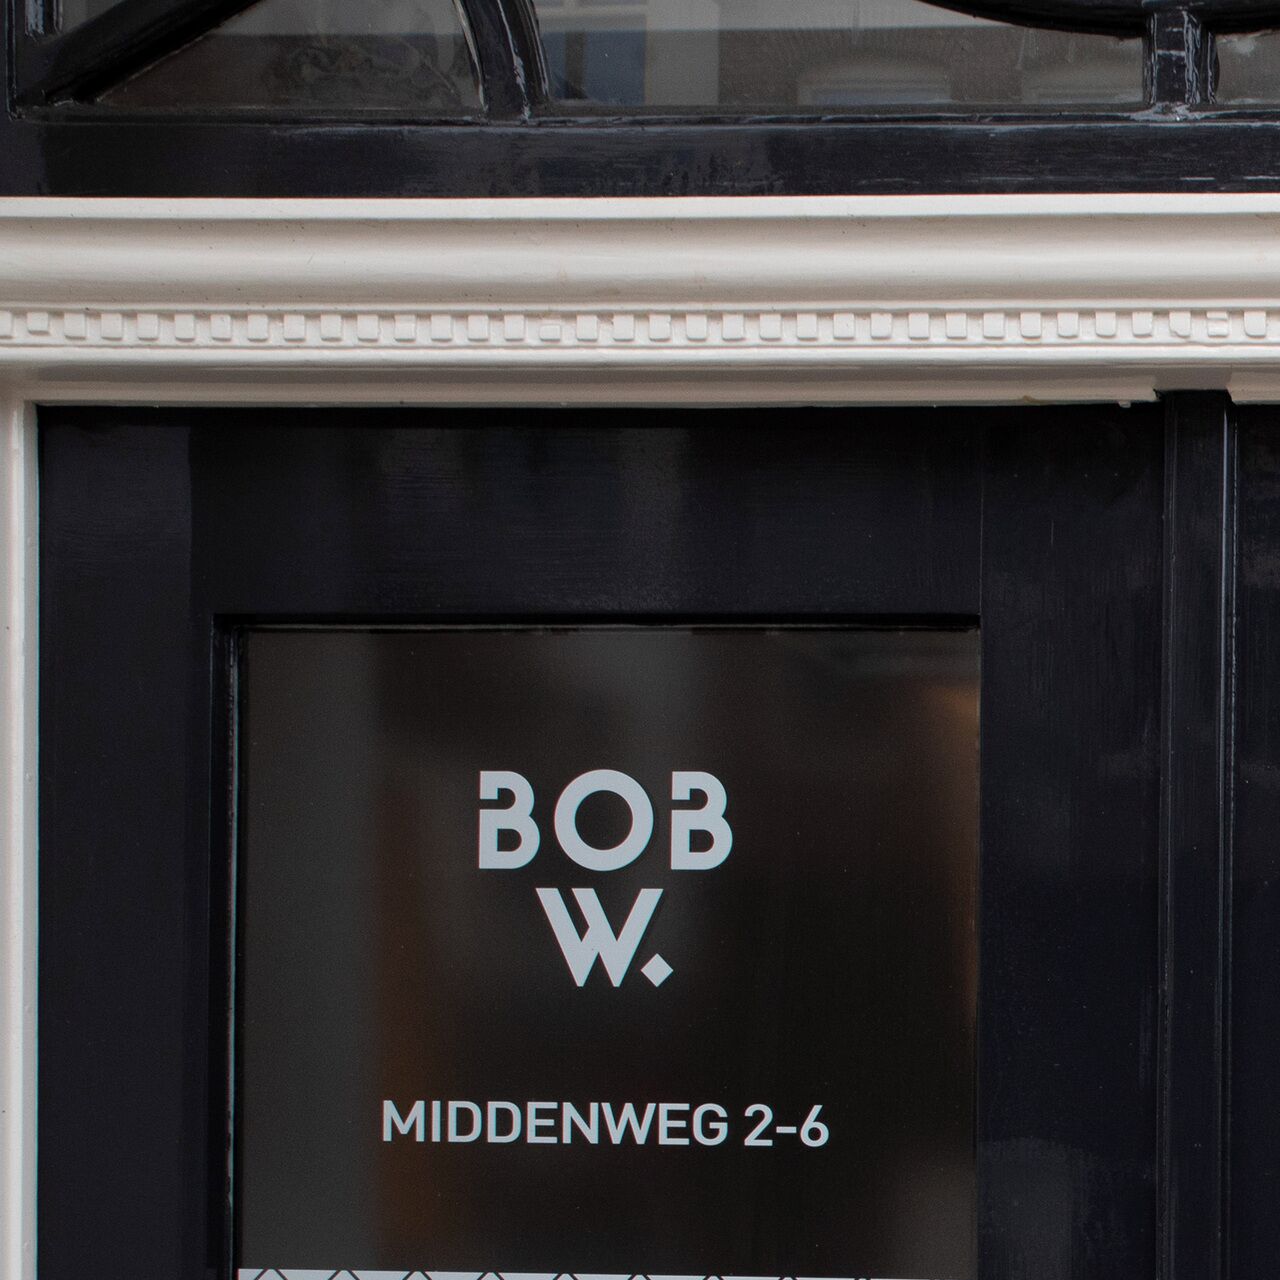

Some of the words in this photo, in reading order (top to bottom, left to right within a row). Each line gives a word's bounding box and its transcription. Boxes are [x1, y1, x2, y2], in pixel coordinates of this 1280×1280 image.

[477, 768, 734, 873] BOB
[534, 886, 675, 988] W.
[382, 1099, 729, 1147] MIDDENWEG
[743, 1103, 830, 1148] 2-6
